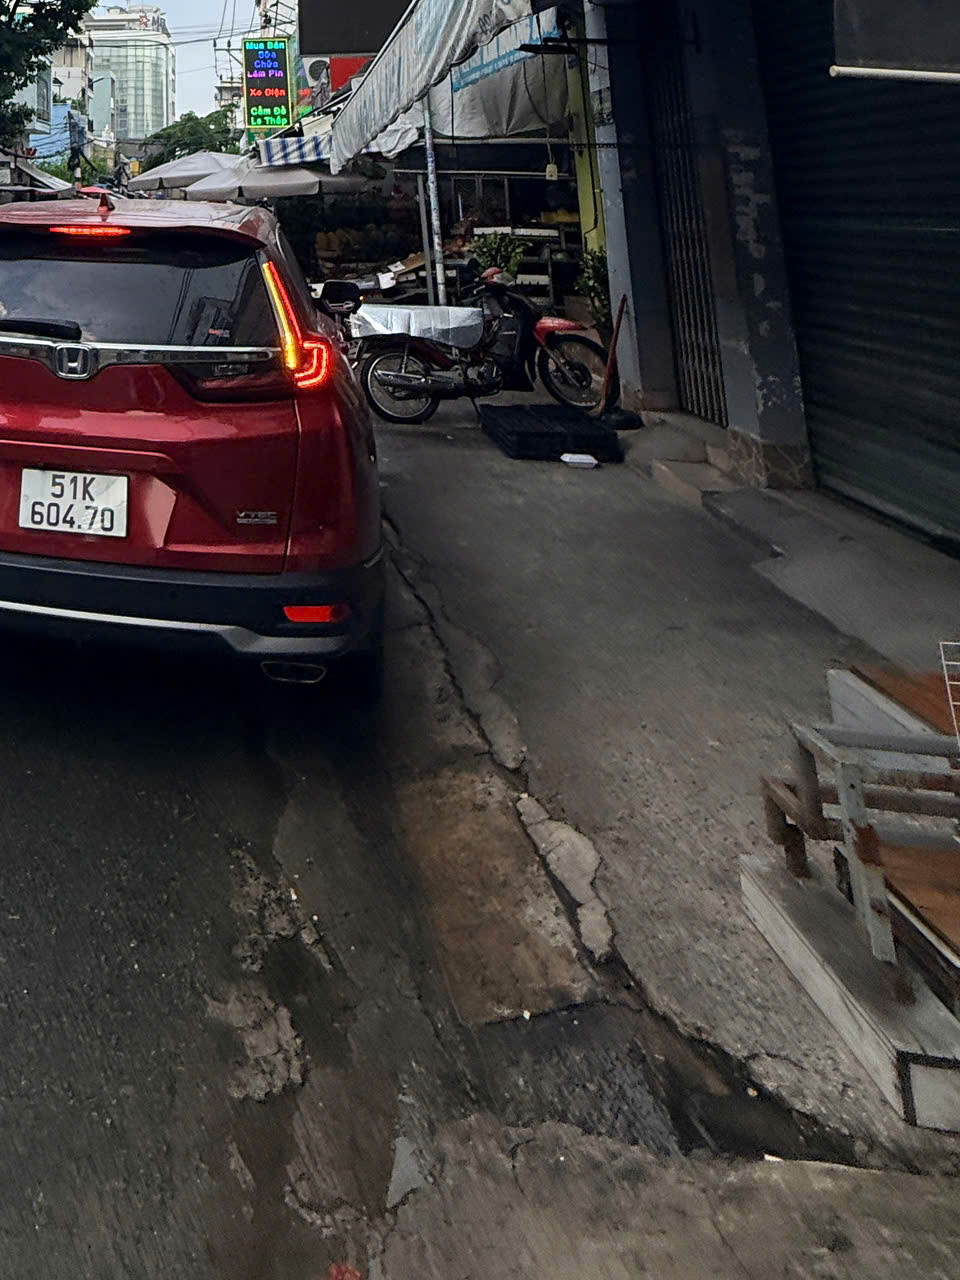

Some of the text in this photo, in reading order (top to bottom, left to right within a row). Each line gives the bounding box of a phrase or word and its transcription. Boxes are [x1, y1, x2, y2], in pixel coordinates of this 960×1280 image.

[269, 69, 283, 77] Pin
[51, 473, 96, 501] 51K
[31, 501, 114, 532] 604.70
